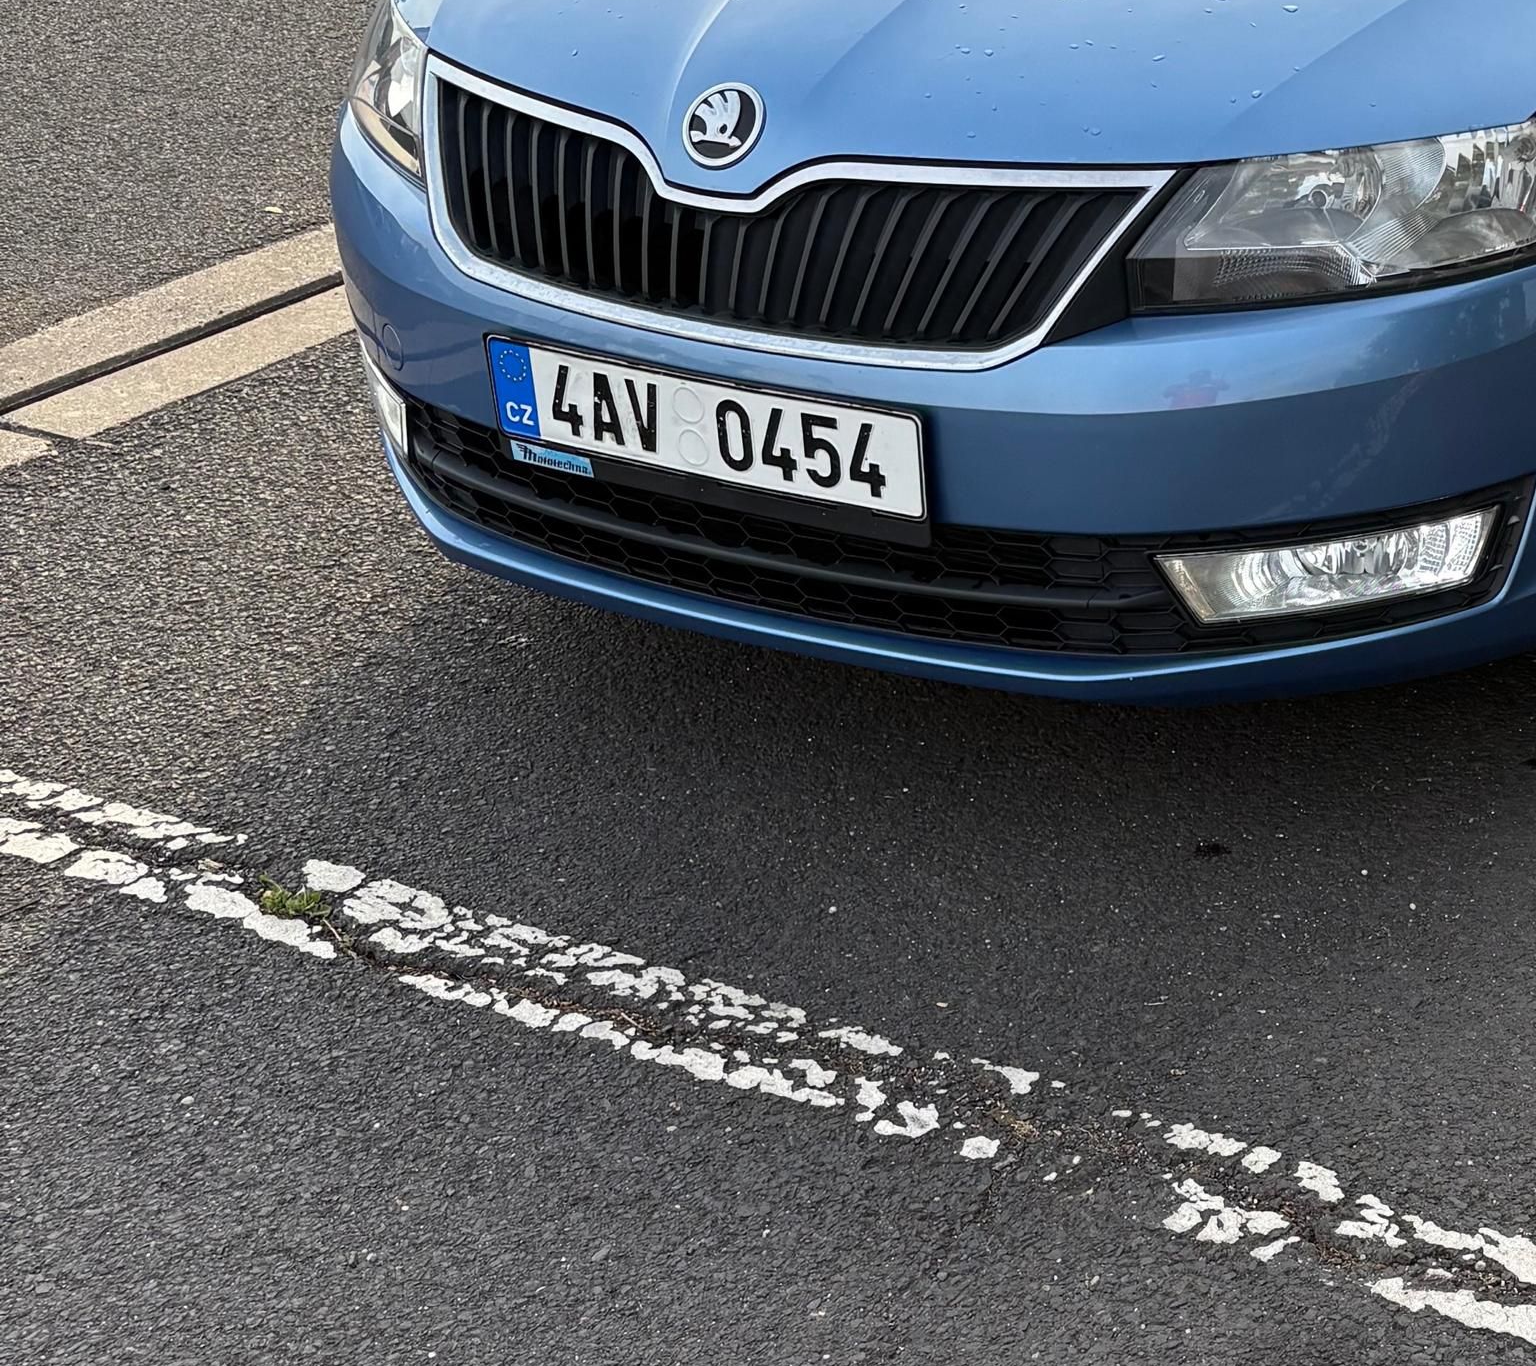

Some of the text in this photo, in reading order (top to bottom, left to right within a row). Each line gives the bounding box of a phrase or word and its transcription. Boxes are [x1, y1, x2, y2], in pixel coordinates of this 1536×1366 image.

[506, 364, 886, 499] CZ 4AV 0454
